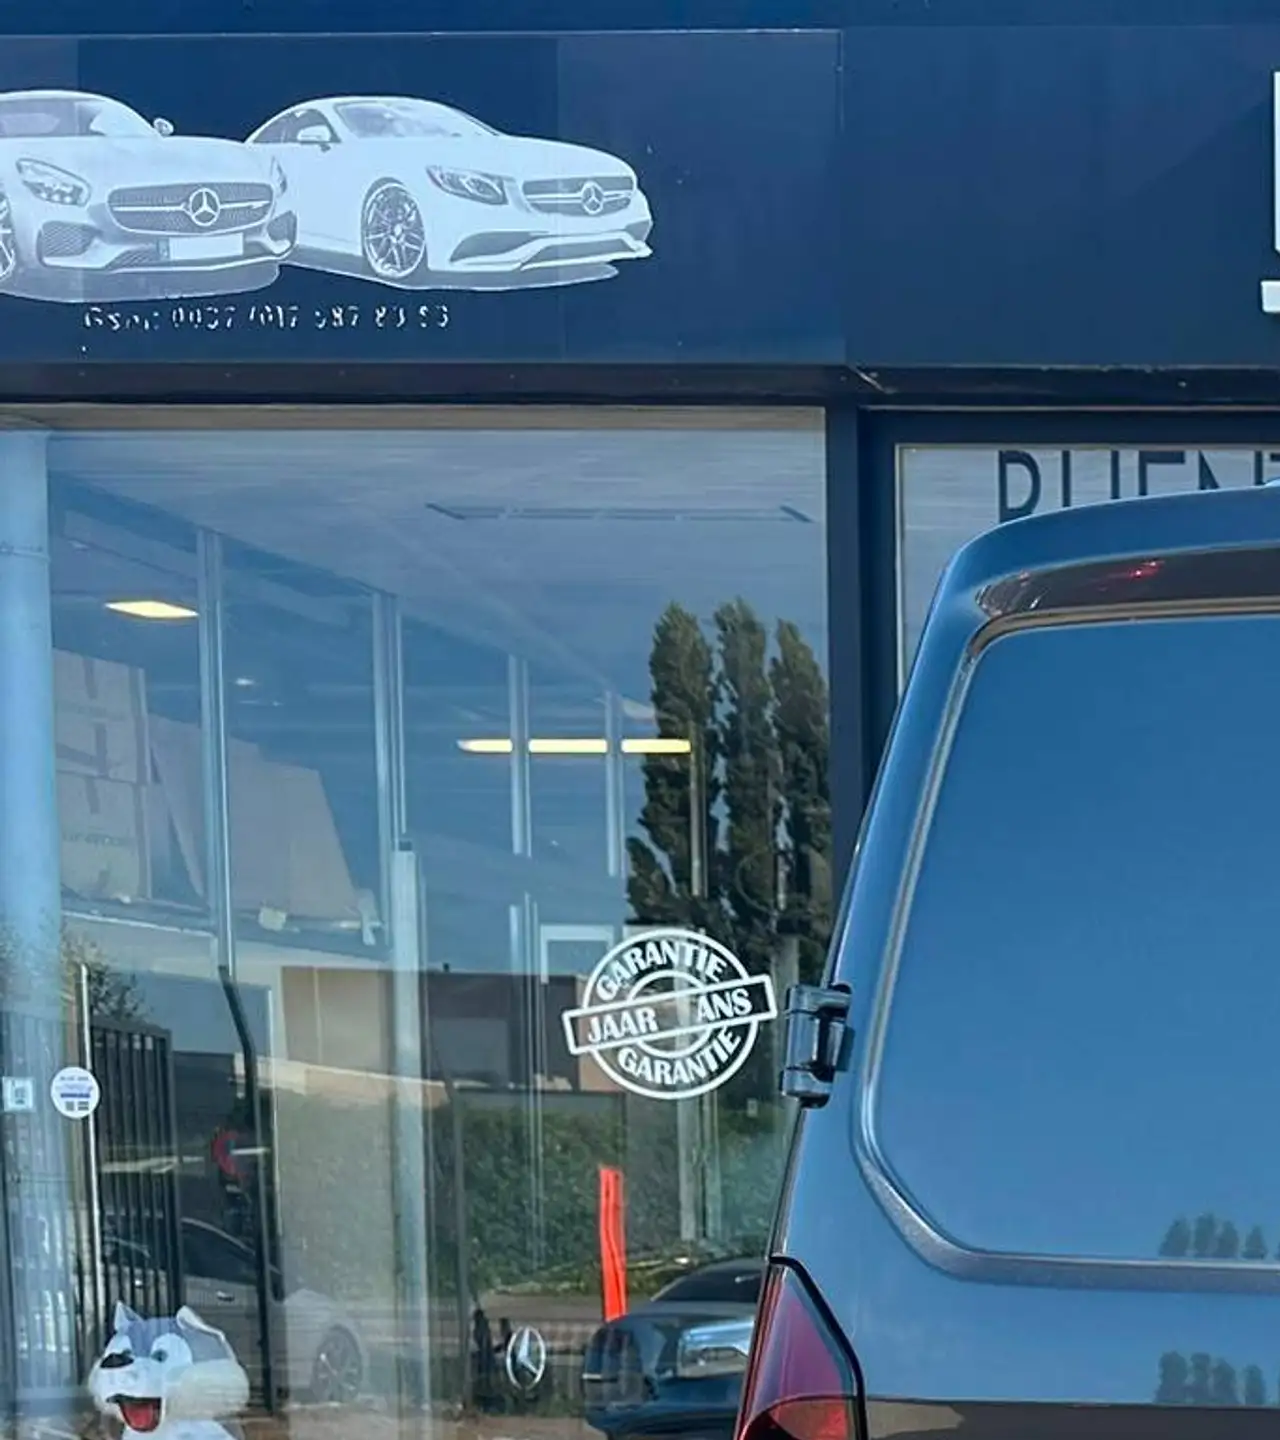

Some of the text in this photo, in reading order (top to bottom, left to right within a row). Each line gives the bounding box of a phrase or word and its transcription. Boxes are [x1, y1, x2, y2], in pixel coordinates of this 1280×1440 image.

[596, 940, 727, 1000] GARANTIE
[587, 987, 753, 1043] JAAR ANS
[617, 1029, 742, 1085] GARANTIE
